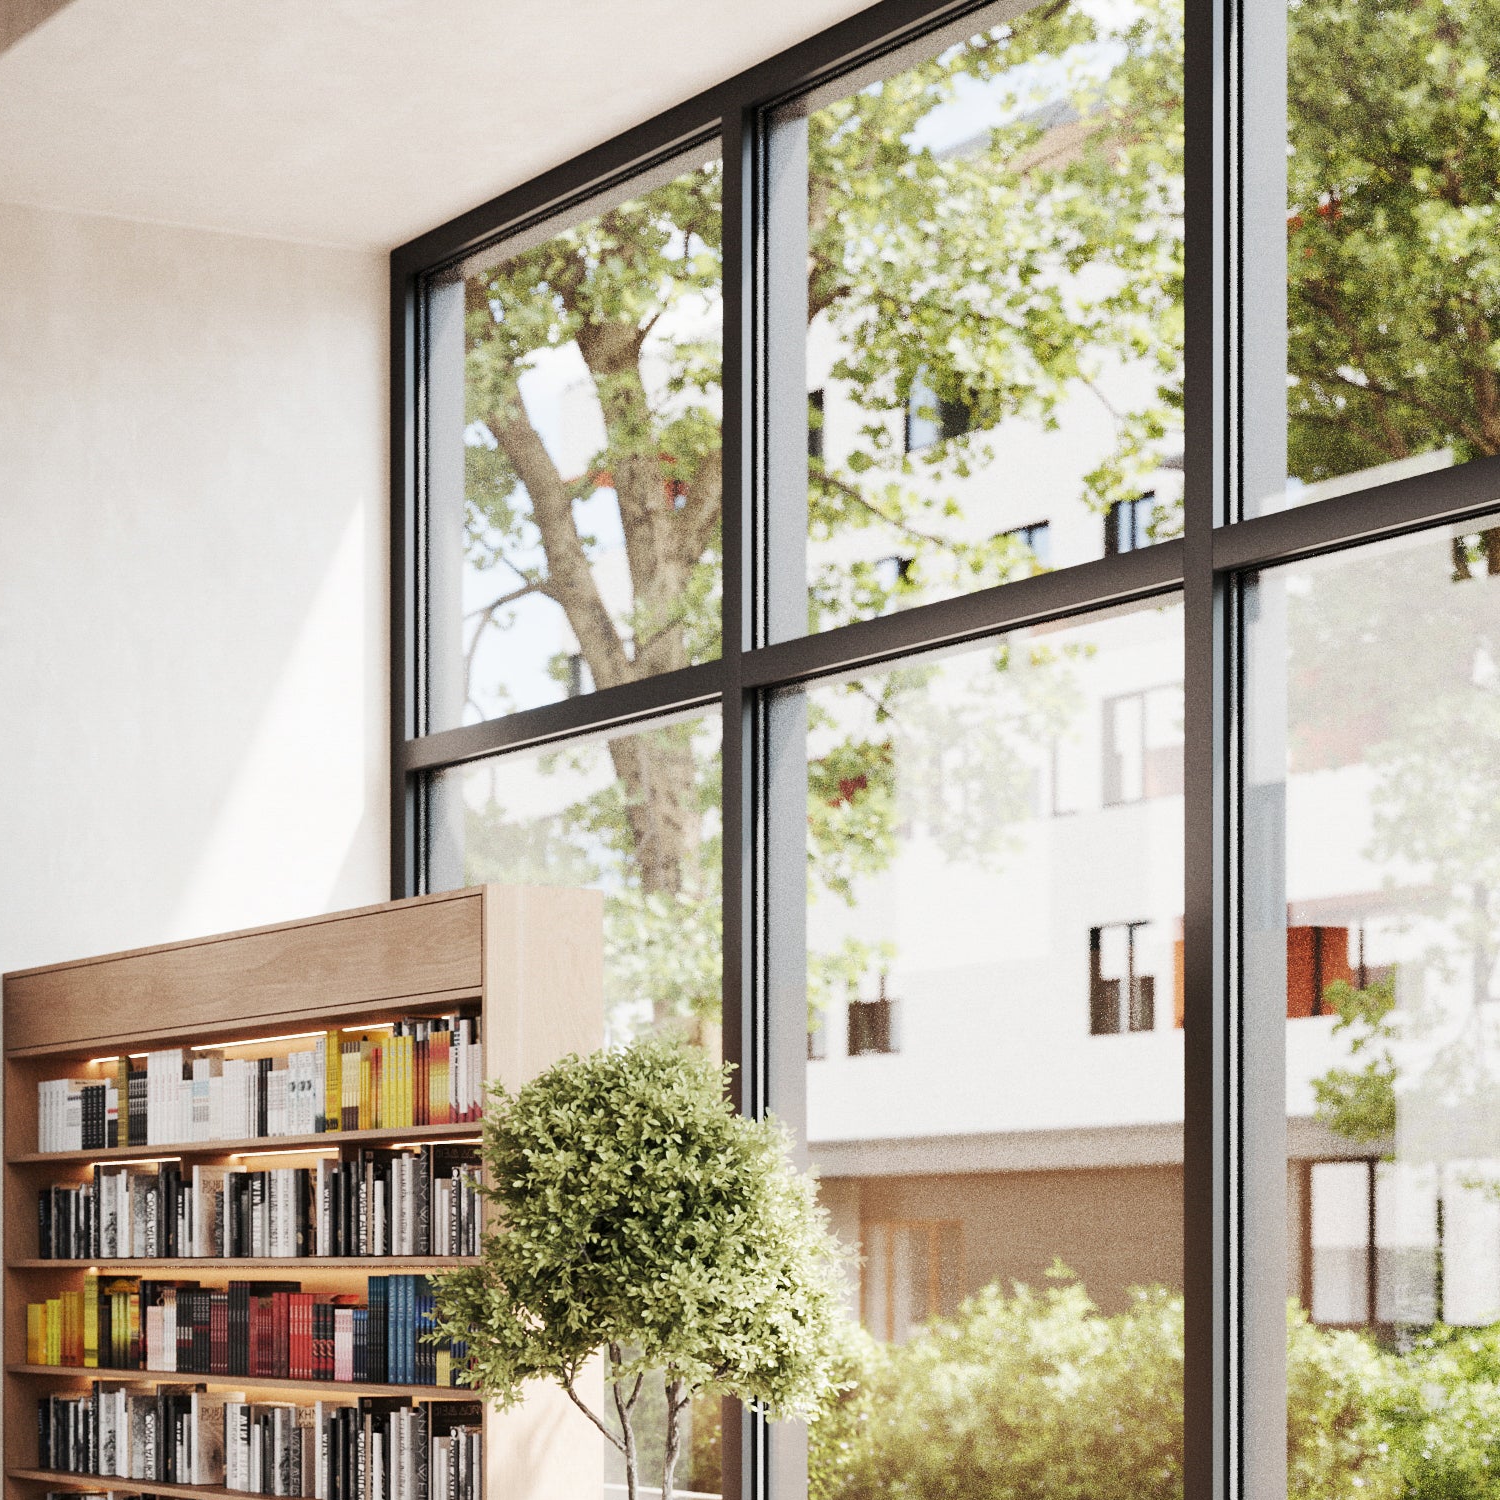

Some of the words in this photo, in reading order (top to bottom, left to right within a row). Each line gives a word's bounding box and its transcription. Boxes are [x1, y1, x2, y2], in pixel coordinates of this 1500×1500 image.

[420, 1149, 428, 1200] ANDY
[253, 1180, 262, 1249] WINTERING
[420, 1206, 428, 1252] WEIR
[418, 1407, 427, 1457] ANDY
